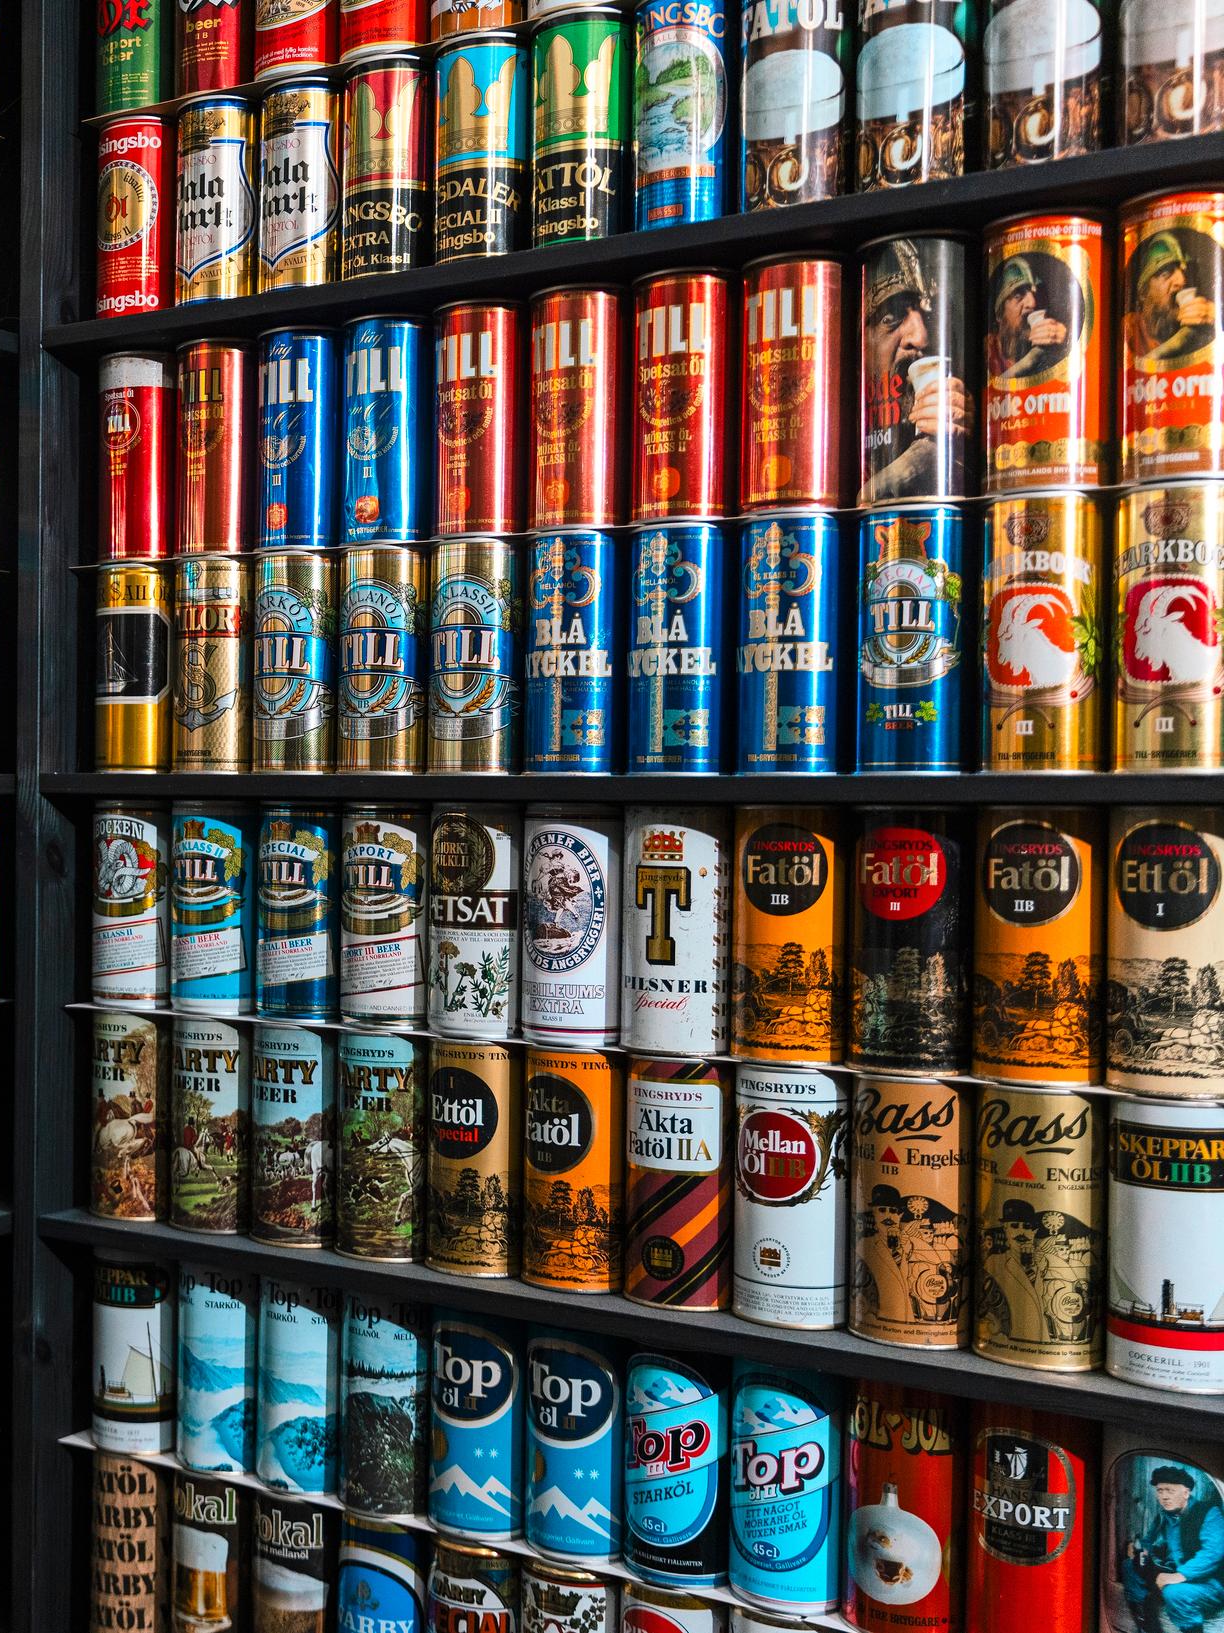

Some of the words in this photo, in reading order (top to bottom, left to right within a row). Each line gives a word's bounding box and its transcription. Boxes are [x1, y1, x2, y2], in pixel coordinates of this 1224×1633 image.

[186, 17, 222, 34] beer
[539, 196, 577, 215] Klass
[639, 303, 706, 359] TILL
[437, 331, 498, 383] TILL
[534, 319, 596, 374] TILL
[347, 346, 402, 396] TILL
[637, 609, 688, 644] BLÅ
[749, 603, 804, 638] BLÅ
[873, 601, 934, 631] TILL
[536, 613, 586, 646] BLÅ
[342, 633, 403, 675] TILL
[433, 630, 499, 670] TILL
[884, 705, 912, 718] TILL
[1016, 722, 1032, 733] III
[1156, 719, 1173, 731] III
[182, 842, 212, 855] KLASS
[348, 846, 394, 858] EXPORT
[176, 860, 218, 882] TILL
[264, 862, 305, 883] TILL
[579, 849, 600, 887] BIER
[747, 854, 820, 887] Fatöl
[860, 853, 938, 886] Fatöl
[989, 857, 1069, 891] Fatöl
[872, 887, 919, 899] EXPORT
[197, 933, 220, 942] BEER
[289, 938, 312, 948] BEER
[376, 944, 400, 953] BEER
[625, 976, 707, 993] PILSNER
[634, 1087, 702, 1102] TINGSRYD'S
[741, 1079, 816, 1095] TINGSRYD'S
[432, 1094, 484, 1127] Ettöl
[639, 1109, 693, 1135] Äkta
[856, 1089, 957, 1133] Bass
[525, 1114, 581, 1147] Fatöl
[980, 1099, 1090, 1149] Bass
[628, 1137, 673, 1162] Fatöl
[744, 1128, 806, 1155] Mellan
[1121, 1132, 1224, 1160] SKEPPAR
[744, 1150, 766, 1174] Öl
[1131, 1155, 1170, 1181] ÖL
[204, 1301, 241, 1309] STARKÖL
[435, 1342, 501, 1397] Top
[1129, 1351, 1184, 1366] COCKERILL
[444, 1387, 460, 1407] öl
[530, 1360, 602, 1417] Top
[540, 1405, 558, 1427] öl
[627, 1417, 711, 1472] Top
[733, 1440, 824, 1493] Top
[633, 1483, 694, 1505] STARKÖL
[744, 1516, 789, 1528] MÖRKARE
[792, 1512, 806, 1521] ÖL
[746, 1508, 763, 1518] ETT
[767, 1501, 799, 1516] NÅGOT
[973, 1490, 1070, 1530] EXPORT
[643, 1520, 654, 1531] 45
[656, 1522, 664, 1532] cl
[748, 1525, 780, 1537] VUXEN
[782, 1520, 807, 1531] SMAK
[753, 1544, 764, 1555] 45
[766, 1547, 777, 1557] cl
